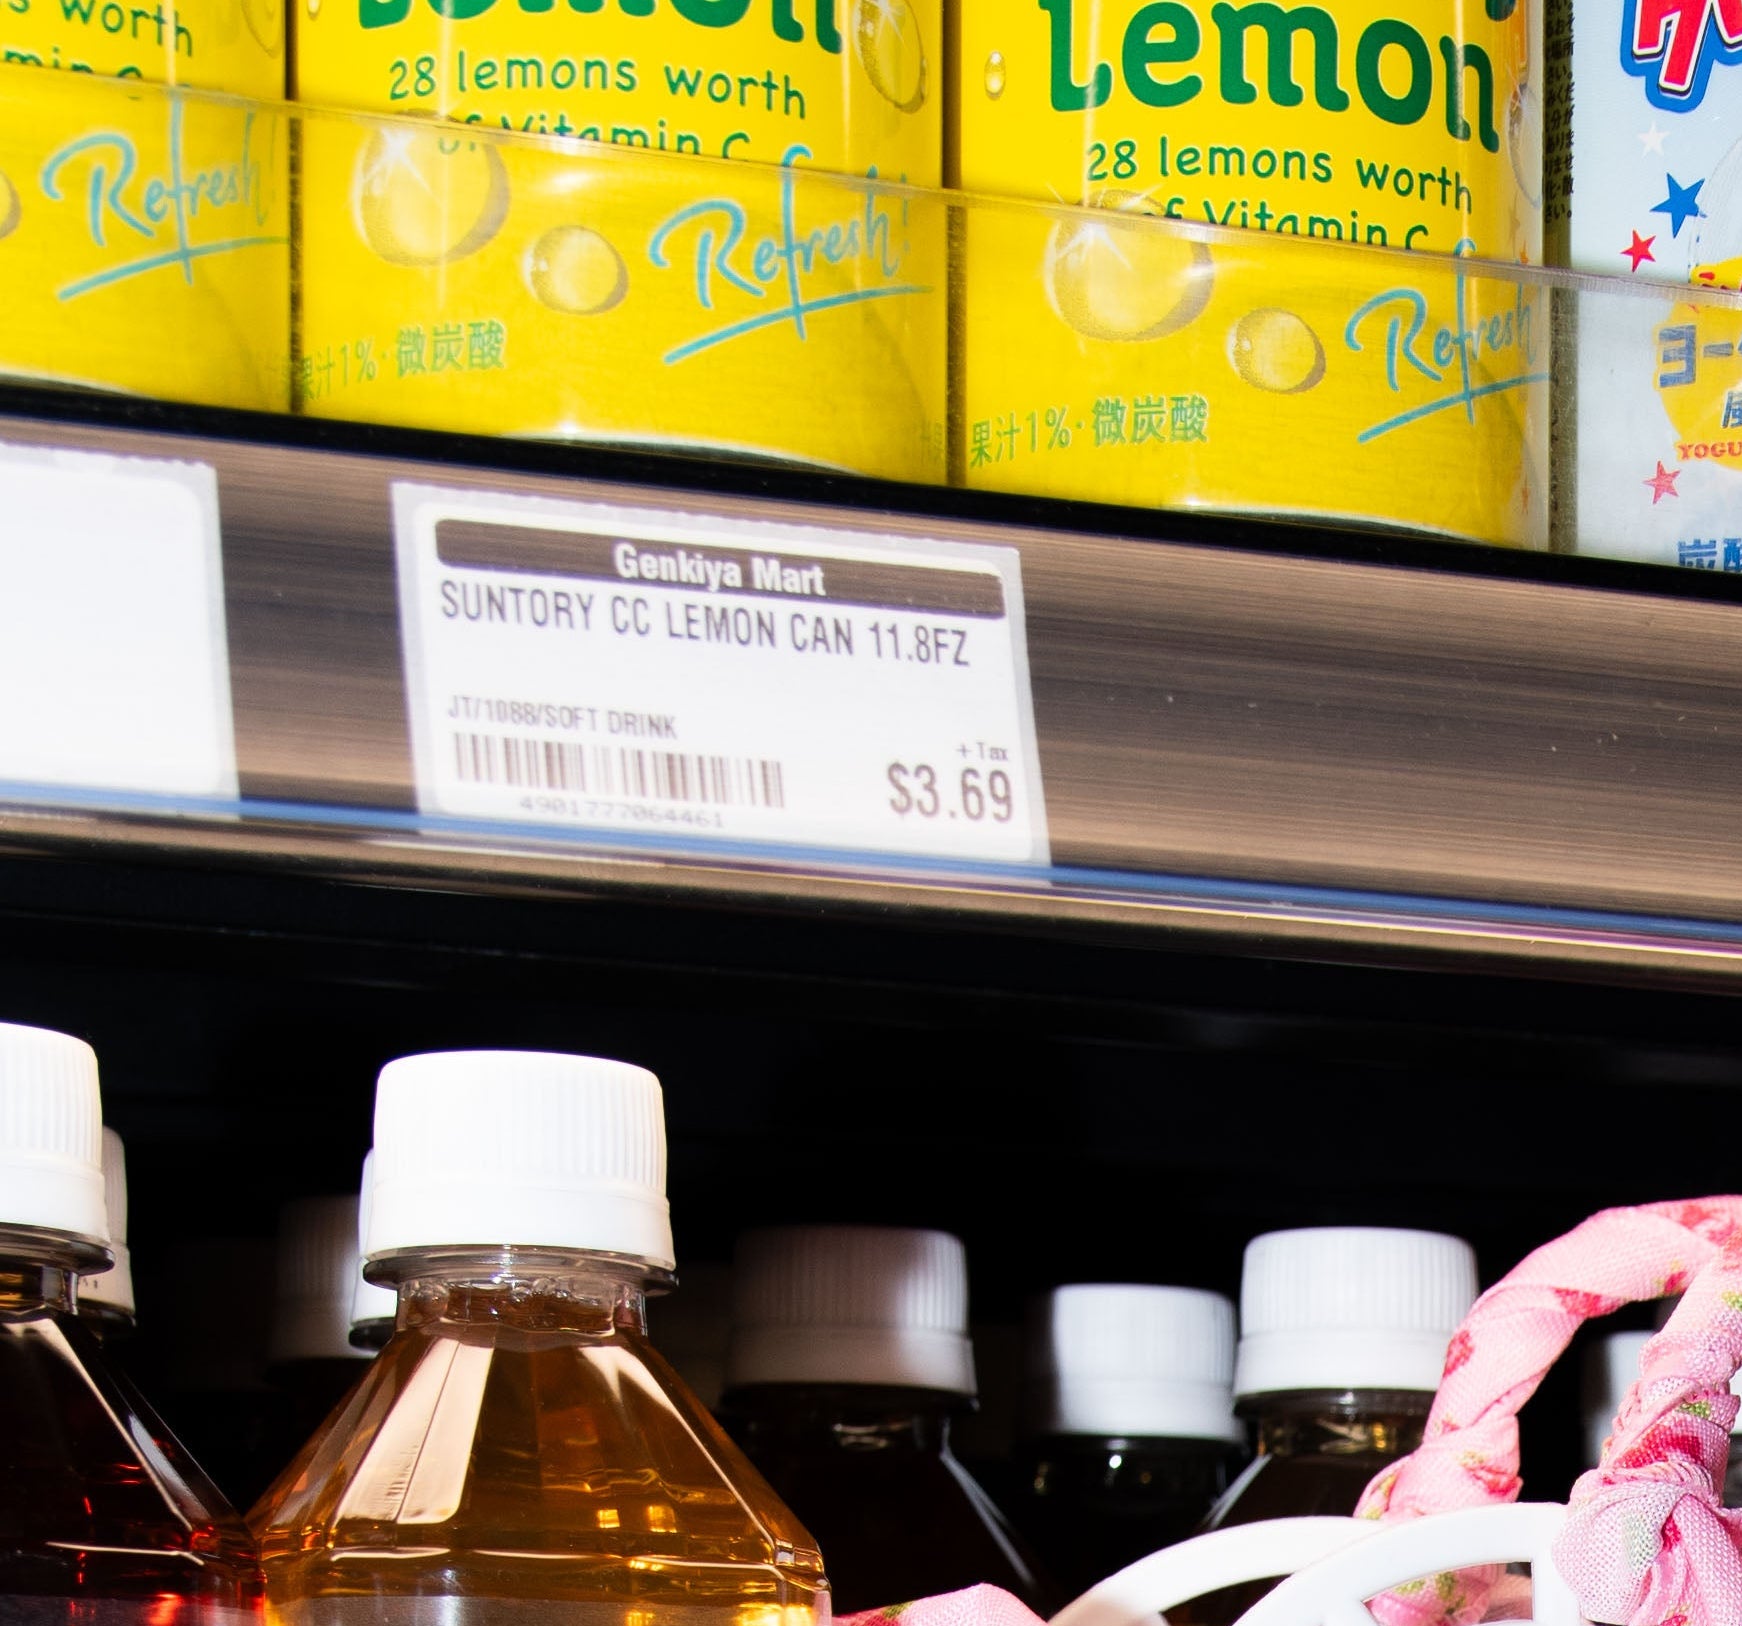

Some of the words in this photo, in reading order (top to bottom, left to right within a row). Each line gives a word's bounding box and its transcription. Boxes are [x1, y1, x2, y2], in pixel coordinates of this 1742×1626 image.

[58, 0, 193, 57] worth
[389, 50, 436, 101] 28
[459, 50, 638, 92] lemons
[664, 62, 806, 119] worth
[1087, 141, 1138, 182] 28
[1159, 134, 1333, 184] lemons
[1356, 157, 1472, 215] worth
[613, 541, 744, 594] Genkiya
[751, 555, 828, 598] Mart
[439, 579, 595, 633] SUNTORY
[610, 595, 652, 638] CC
[666, 601, 777, 650] LEMON
[790, 612, 855, 657] CAN
[866, 621, 972, 669] 11.8FZ
[607, 709, 679, 740] DRINK
[887, 760, 1016, 825] $3.69
